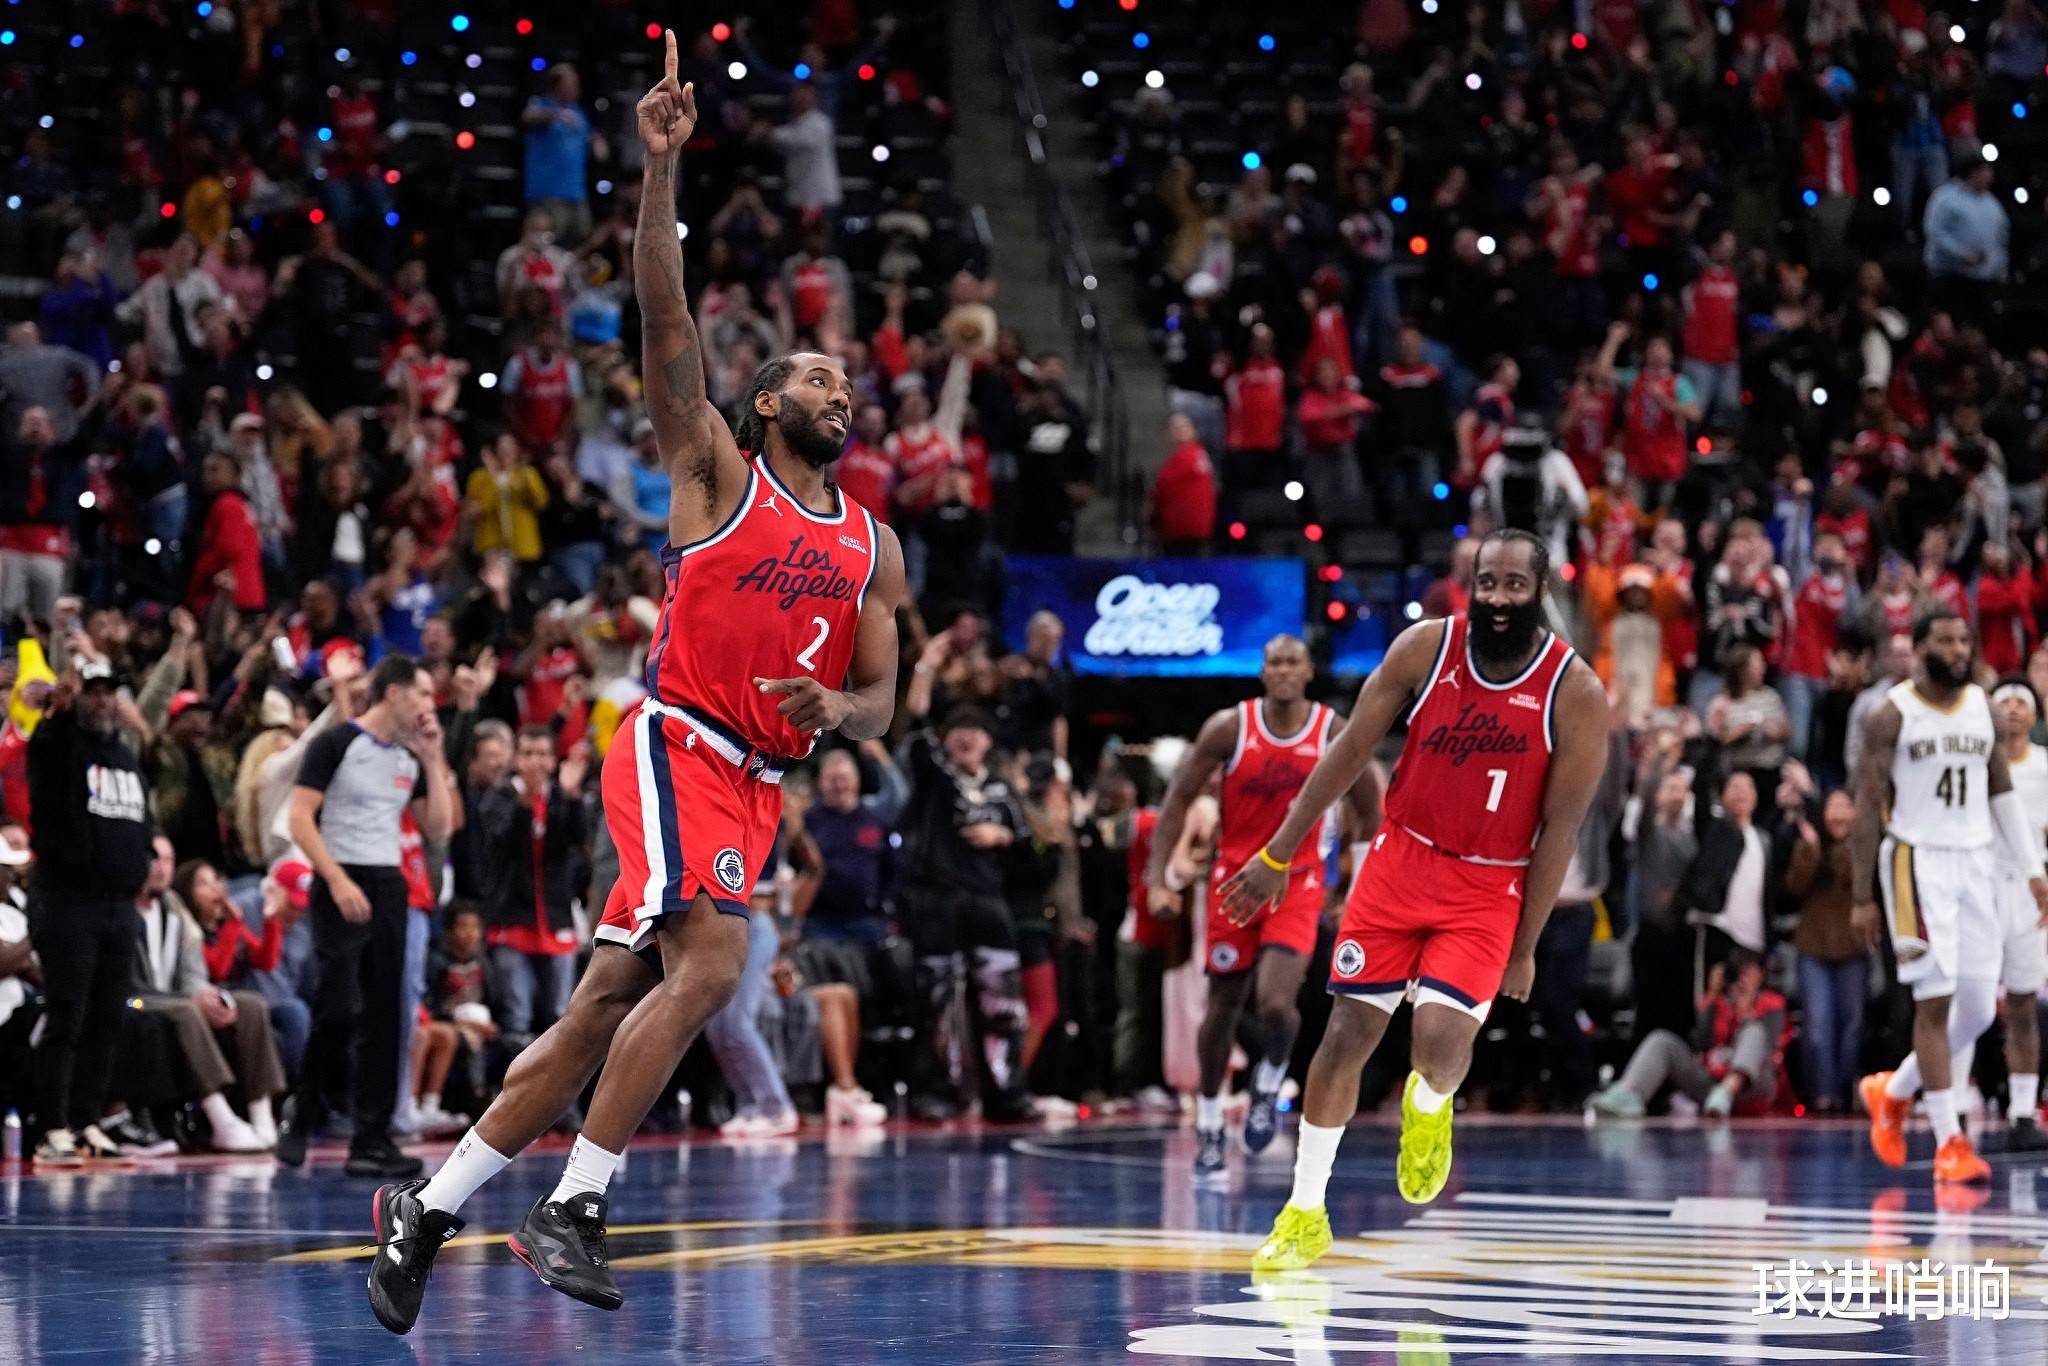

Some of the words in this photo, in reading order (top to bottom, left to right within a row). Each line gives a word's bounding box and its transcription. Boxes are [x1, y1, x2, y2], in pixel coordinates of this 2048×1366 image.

[781, 535, 833, 570] Los
[733, 558, 856, 611] Angeles
[796, 616, 830, 672] 2
[1451, 702, 1499, 732] Los
[1421, 724, 1528, 767] Angeles
[1486, 769, 1508, 812] 1
[1935, 764, 1967, 807] 41
